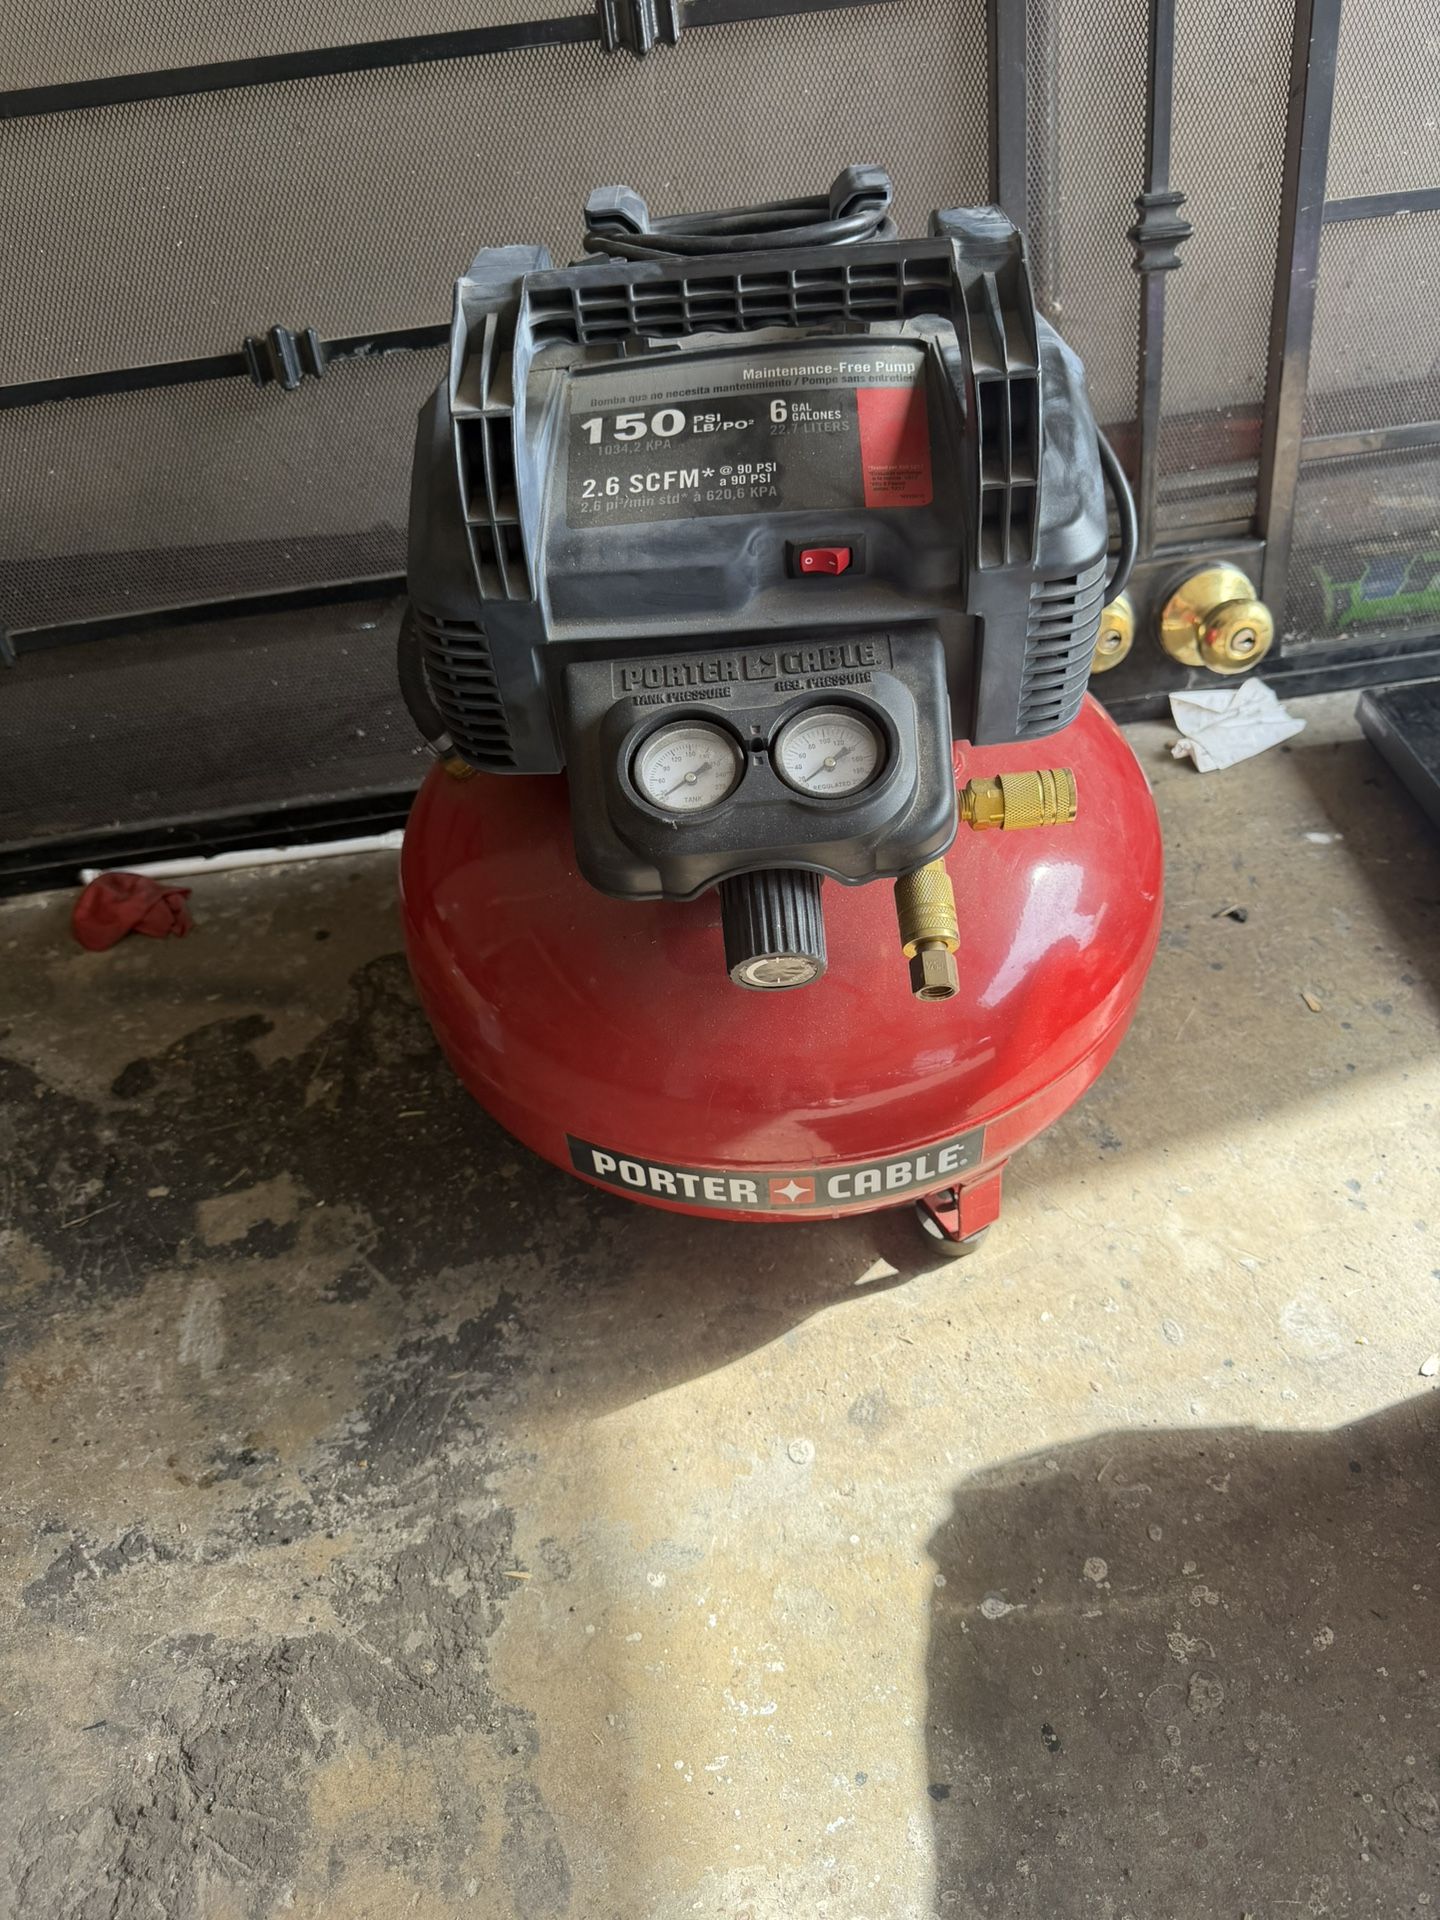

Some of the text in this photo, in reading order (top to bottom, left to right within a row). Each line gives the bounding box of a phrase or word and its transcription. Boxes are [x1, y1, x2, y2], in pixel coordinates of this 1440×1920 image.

[743, 361, 916, 380] Maintenance-Free Pump
[590, 395, 626, 407] Bomba
[650, 392, 663, 401] no
[666, 387, 710, 399] necesita
[713, 375, 792, 394] mantenimiento
[802, 374, 838, 387] Pompe
[841, 374, 866, 383] sans
[770, 399, 788, 423] 6
[792, 403, 812, 412] GAL
[792, 410, 842, 422] GALONES
[580, 408, 686, 445] 150
[693, 413, 721, 424] PSI
[770, 420, 850, 436] 22.7 LITERS
[646, 439, 672, 451] KPA
[719, 462, 777, 476] @ 90 PSI
[582, 476, 620, 499] 2.6
[731, 475, 746, 486] 90
[750, 473, 771, 484] PSI
[580, 500, 601, 513] 2.6
[750, 486, 777, 498] KPA
[621, 641, 876, 692] PORTER CABLE
[775, 671, 873, 693] REG. PRESSURE
[632, 686, 732, 706] TANK PRESSURE
[813, 781, 852, 791] REGULATED
[591, 1143, 966, 1203] PORTER CABLE
